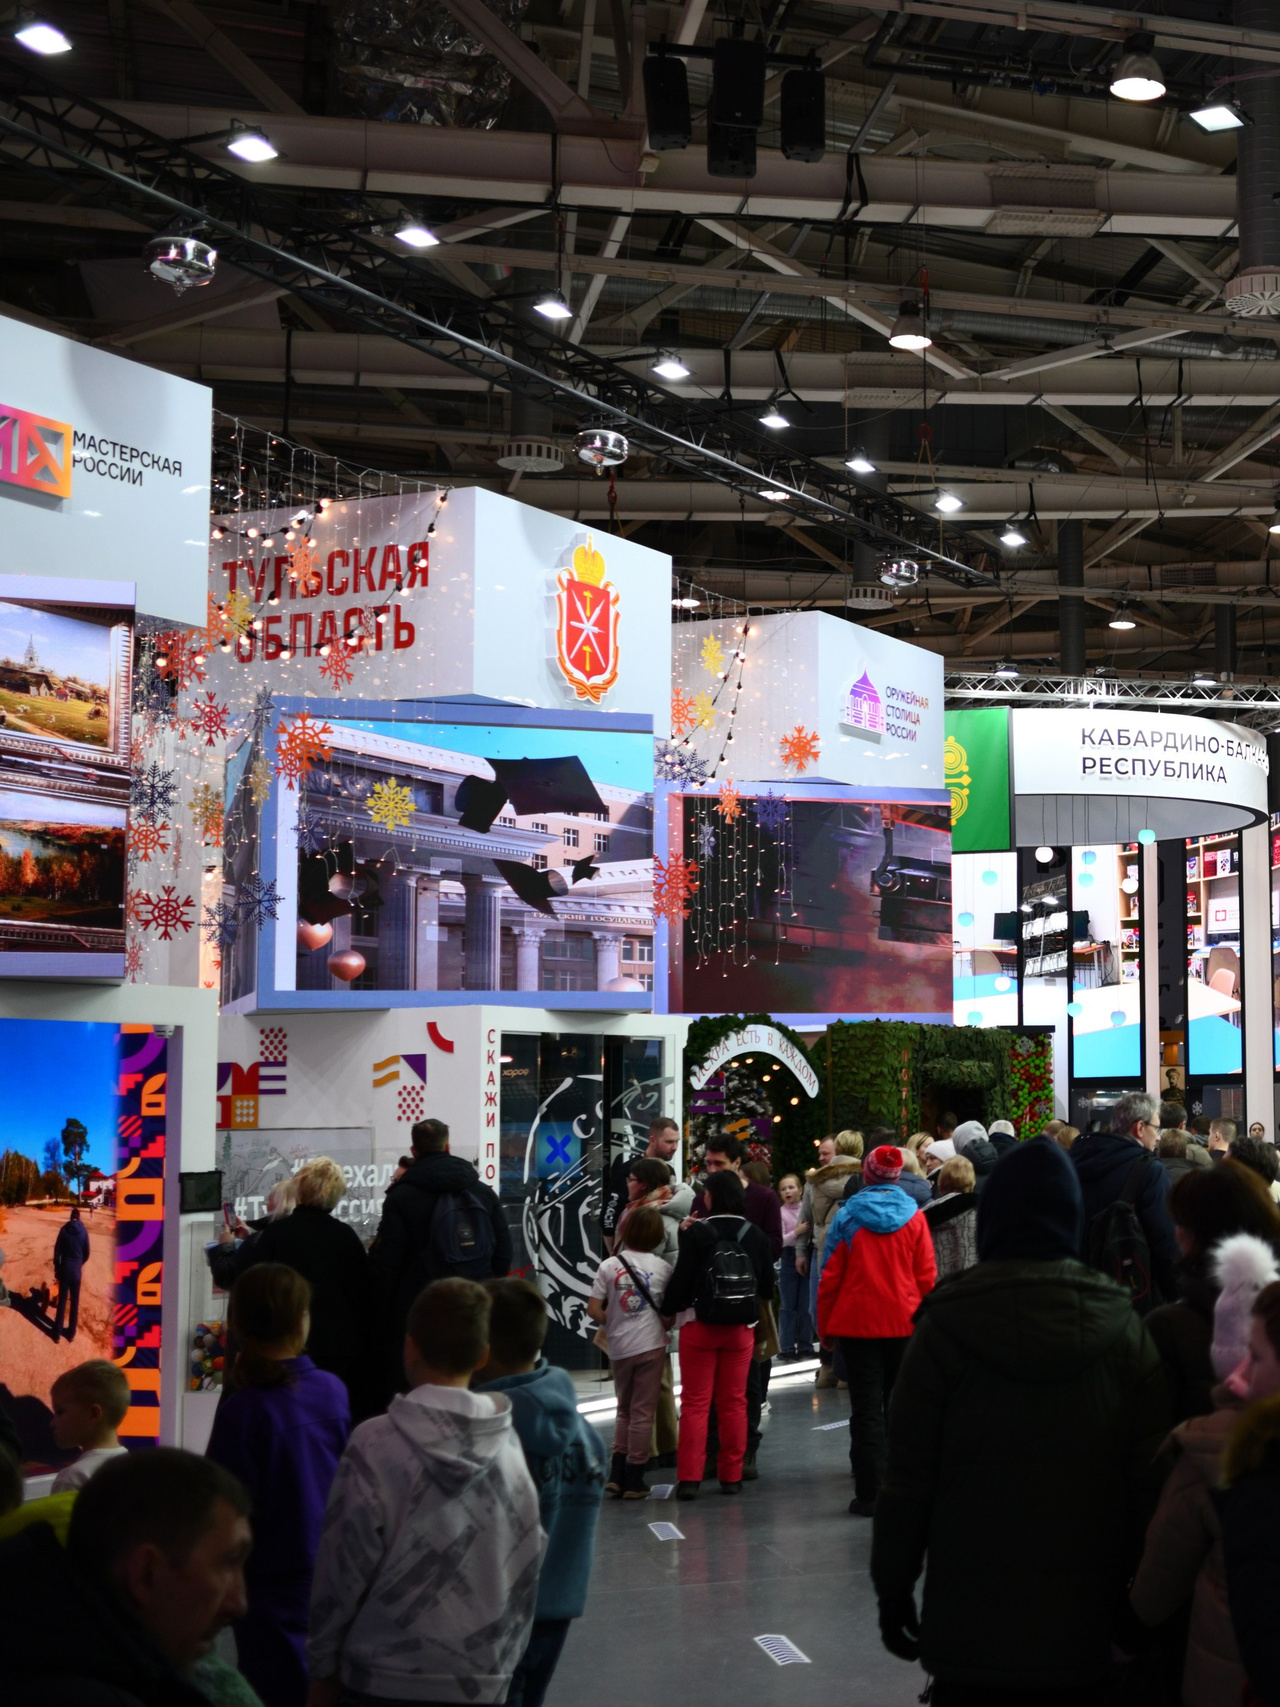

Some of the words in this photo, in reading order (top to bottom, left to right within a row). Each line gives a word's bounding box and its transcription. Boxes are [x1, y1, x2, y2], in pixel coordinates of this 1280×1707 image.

[72, 430, 182, 477] МАСТЕРСКАЯ
[72, 452, 143, 487] РОССИИ
[885, 685, 929, 710] ОРУЖЕЙНАЯ
[885, 704, 921, 726] СТОЛИЦА
[885, 722, 917, 742] РОССИИ
[1081, 756, 1228, 784] РЕСПУБЛИКА
[531, 911, 586, 921] ТУЛСКИЙ
[693, 1039, 730, 1083] ИСКРА
[736, 1029, 761, 1047] ЕСТЬ
[767, 1032, 774, 1046] В
[778, 1037, 817, 1092] КАЖДОМ
[484, 1028, 498, 1128] СКАЖИ
